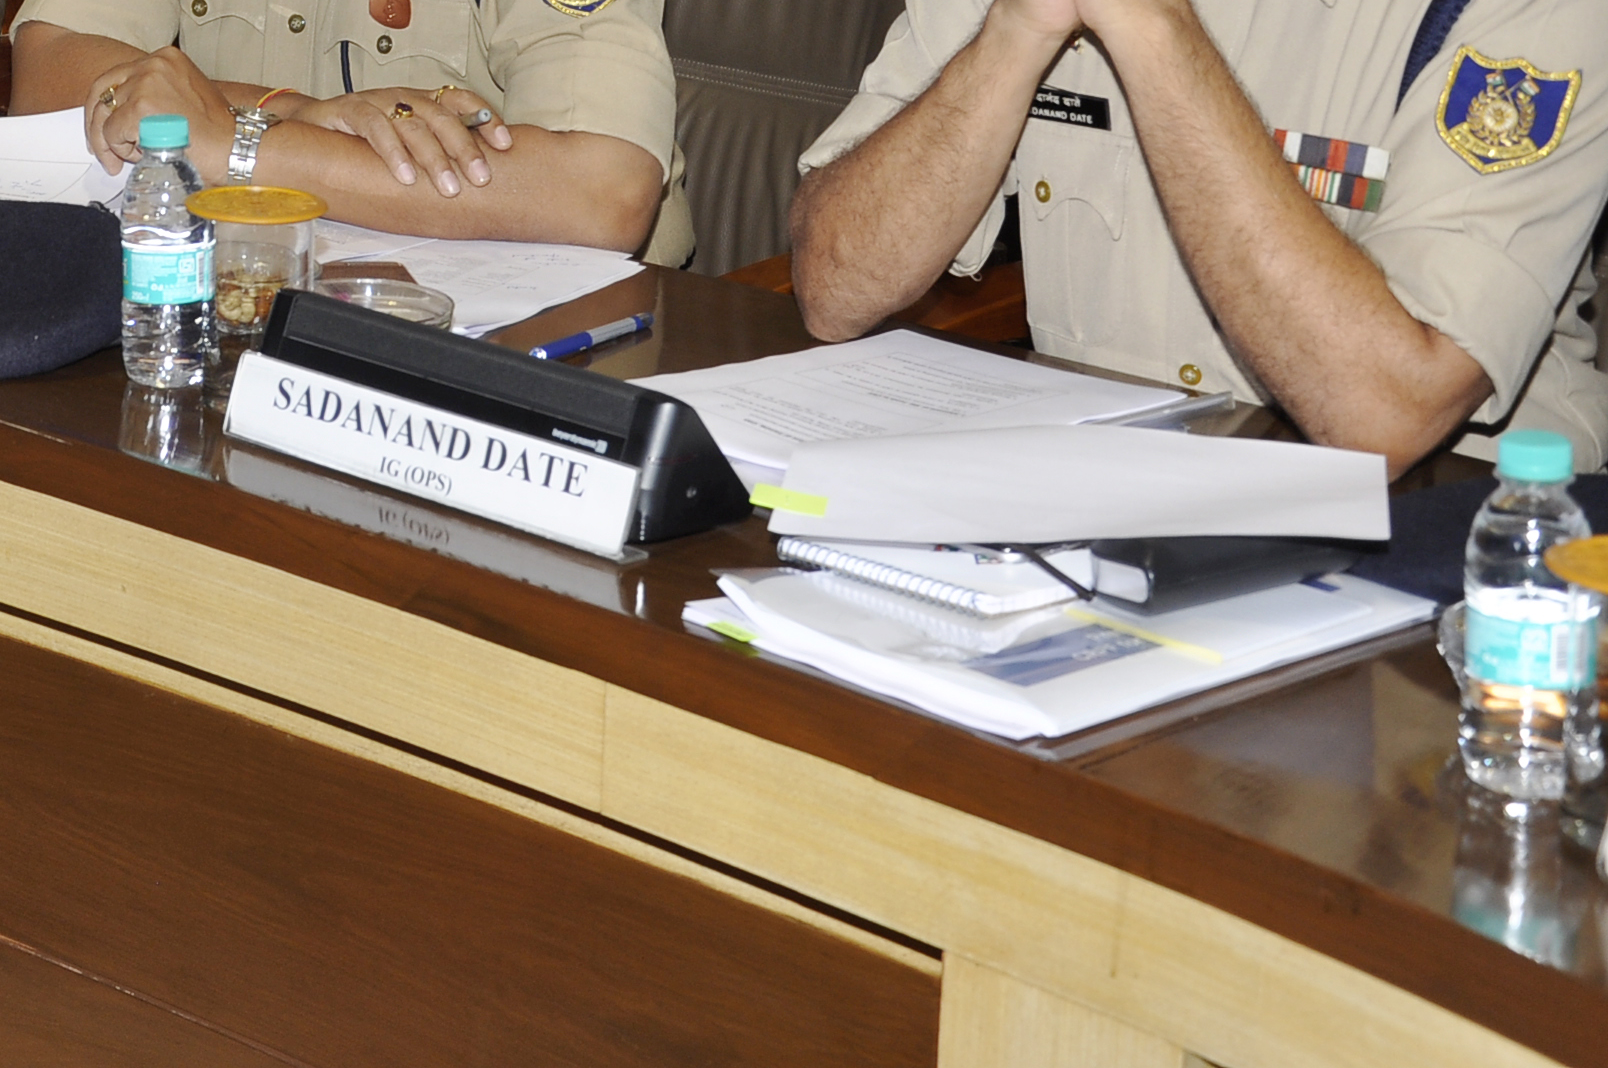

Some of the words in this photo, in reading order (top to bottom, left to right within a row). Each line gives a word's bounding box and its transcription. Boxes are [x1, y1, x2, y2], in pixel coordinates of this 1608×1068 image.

[1031, 107, 1068, 120] DANAND
[1069, 113, 1094, 124] DATE
[272, 377, 472, 461] SADANAND
[480, 437, 589, 498] DATE
[379, 455, 401, 478] IG
[403, 464, 452, 496] (OPS)
